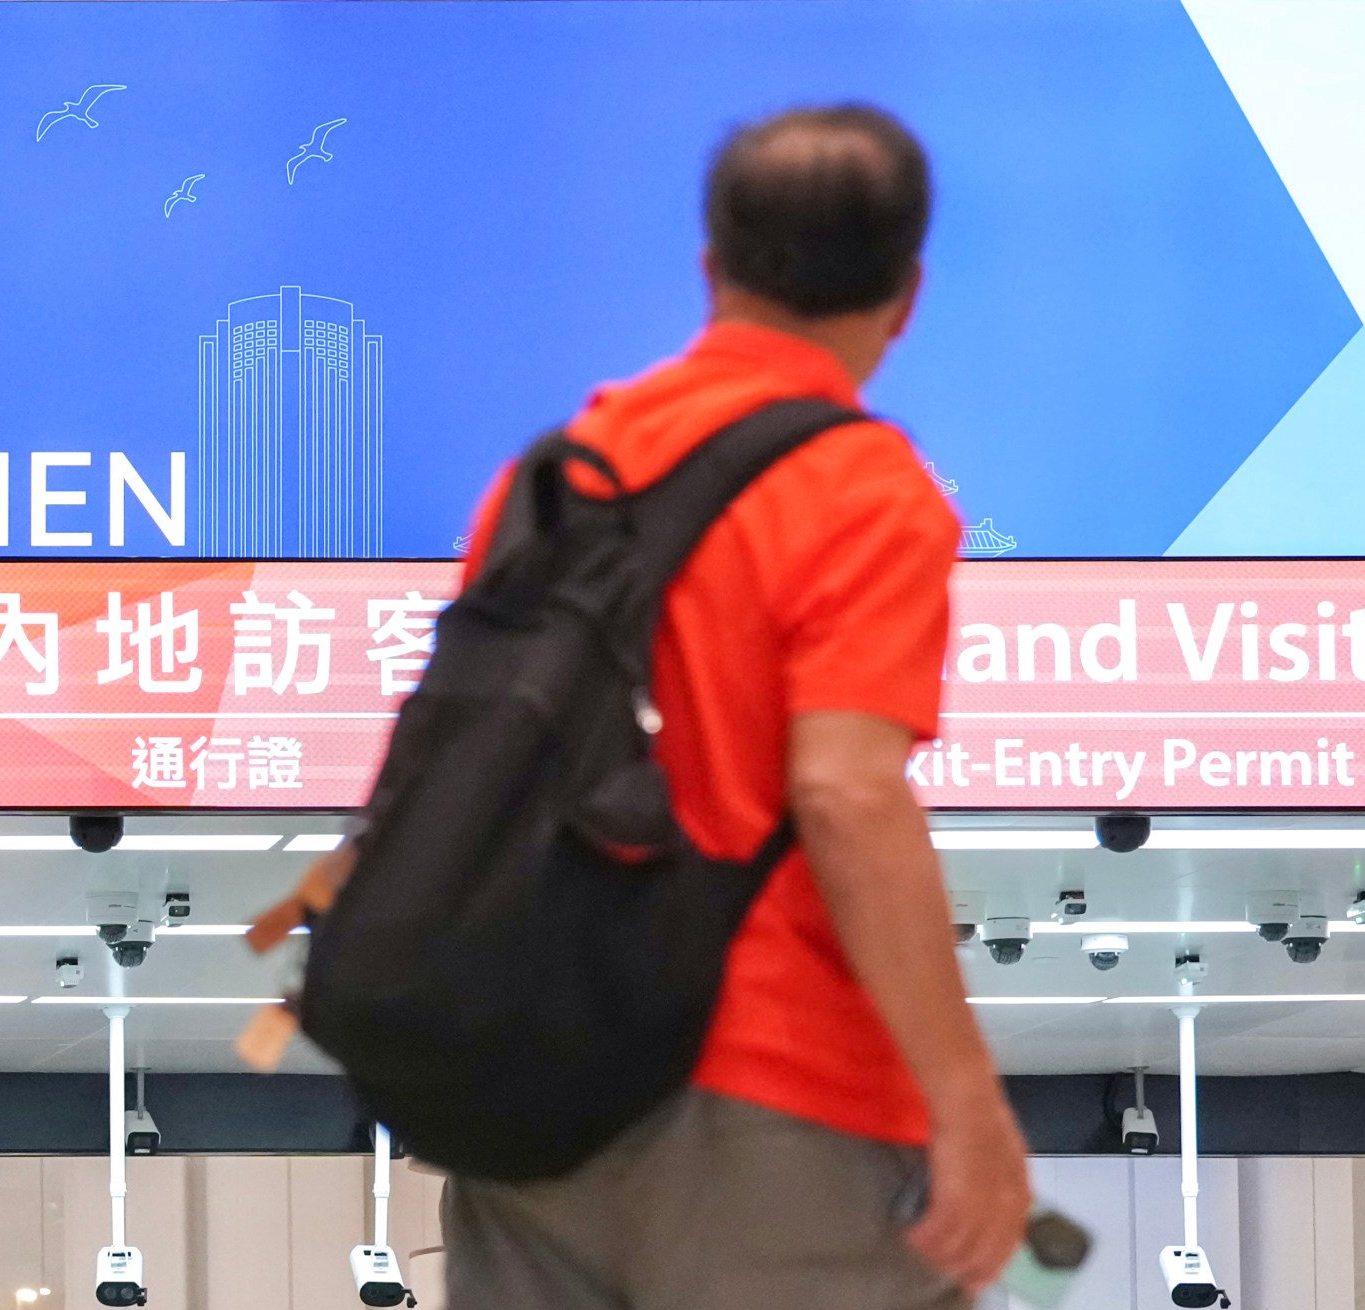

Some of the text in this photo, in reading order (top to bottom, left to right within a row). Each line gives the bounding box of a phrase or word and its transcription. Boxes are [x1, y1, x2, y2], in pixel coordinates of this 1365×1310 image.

[943, 599, 1138, 683] and
[131, 735, 303, 790] 通行證
[906, 737, 1355, 801] xit-Entry Permit
